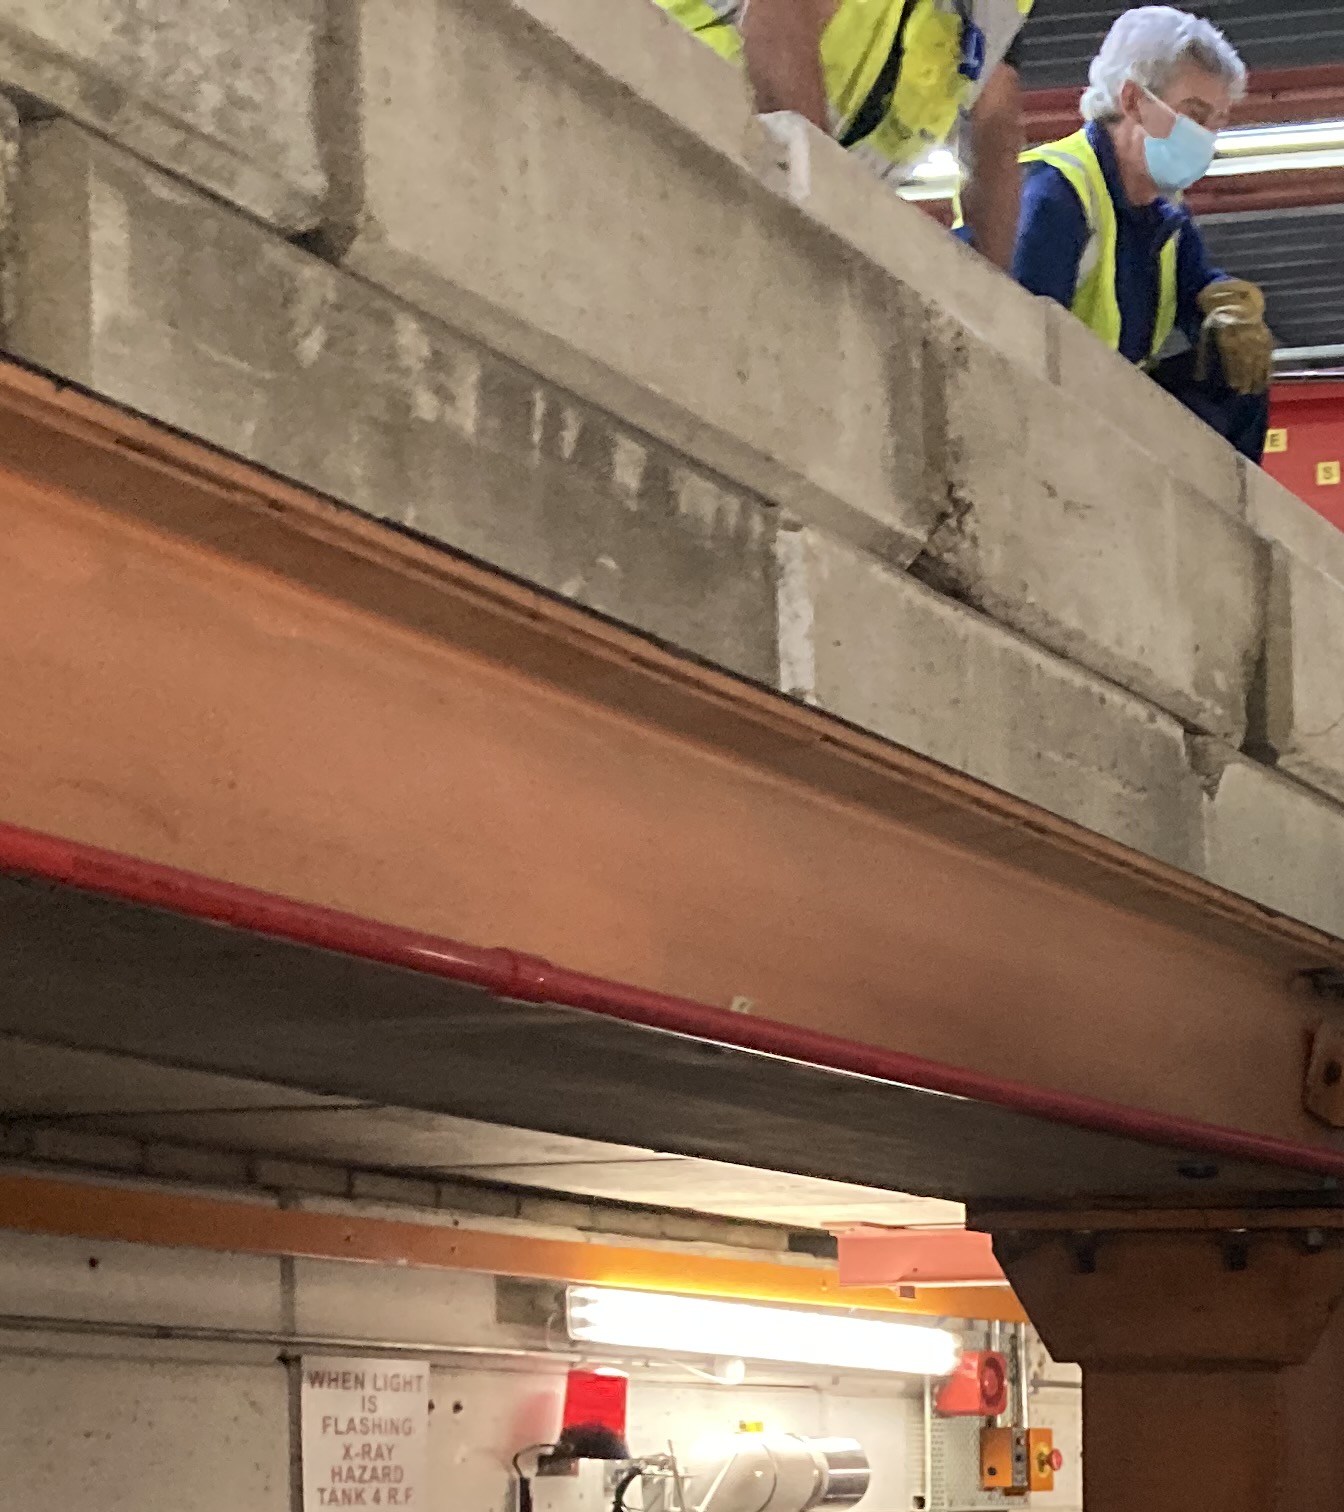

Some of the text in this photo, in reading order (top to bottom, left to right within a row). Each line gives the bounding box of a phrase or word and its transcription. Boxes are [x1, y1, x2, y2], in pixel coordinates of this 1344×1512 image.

[1269, 433, 1280, 447] E
[1322, 466, 1333, 479] S
[309, 1371, 424, 1392] WHEN LIGHT
[361, 1395, 378, 1413] IS
[322, 1416, 413, 1436] FLASHING
[342, 1443, 395, 1461] X-RAY
[331, 1465, 404, 1484] HAZARD
[317, 1487, 366, 1506] TANK
[371, 1487, 382, 1505] 4
